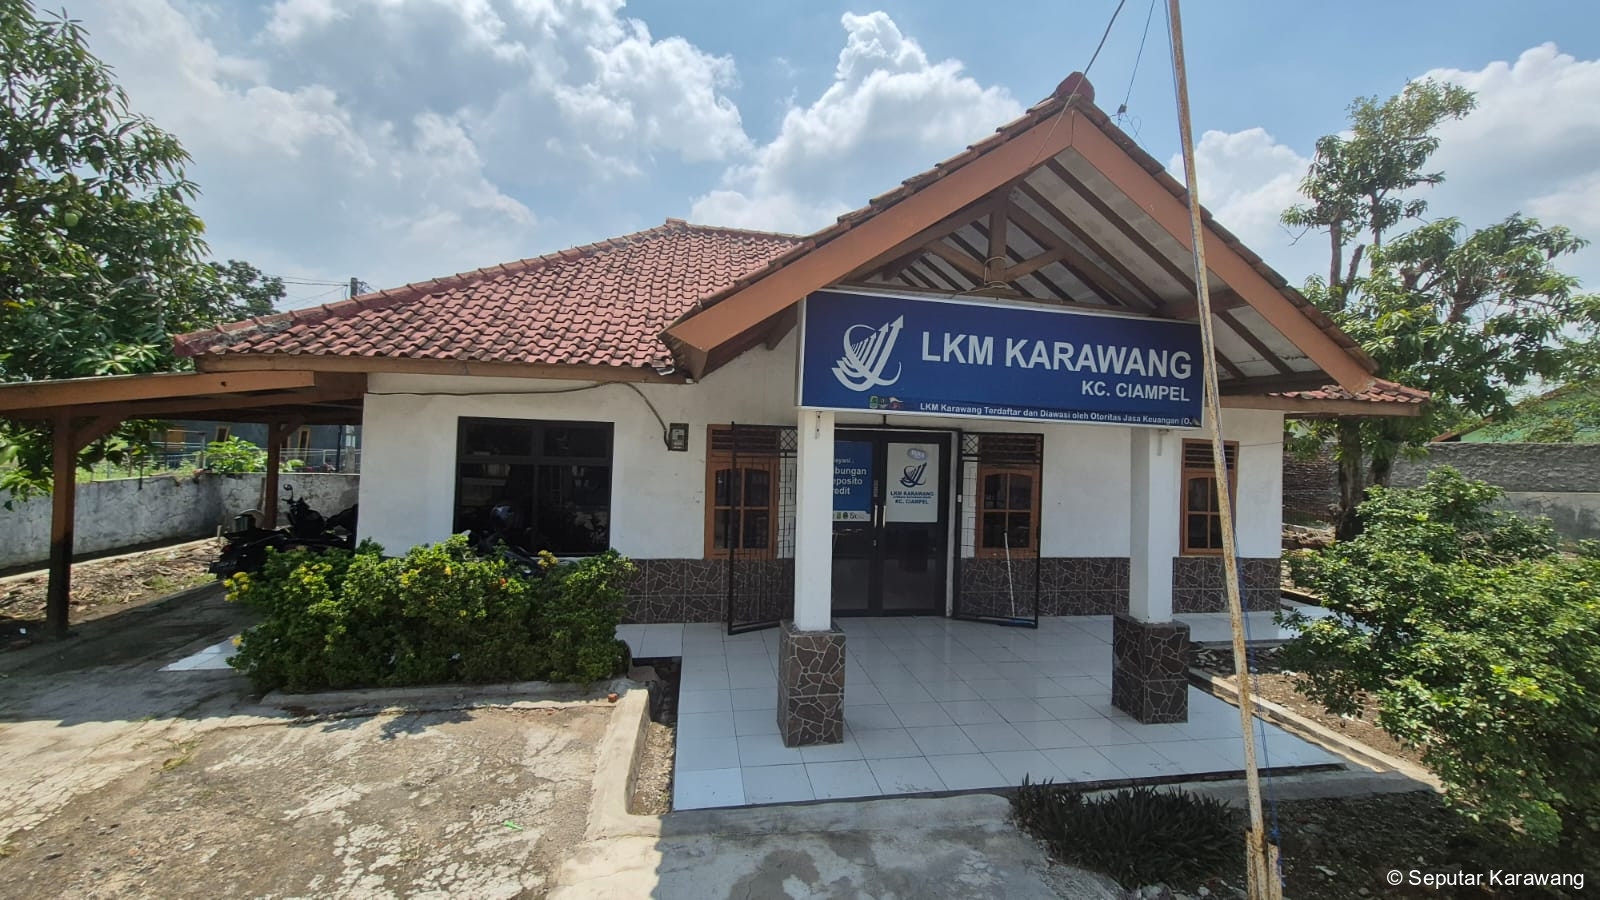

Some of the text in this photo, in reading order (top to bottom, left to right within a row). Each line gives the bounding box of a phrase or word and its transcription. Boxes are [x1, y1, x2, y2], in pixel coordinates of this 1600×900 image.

[921, 331, 1192, 380] LKM KARAWANG
[1081, 380, 1190, 402] KC. CIAMPEL
[920, 402, 939, 411] LKM
[940, 403, 982, 415] Karawang
[984, 406, 1022, 416] Terdaftar
[1023, 408, 1038, 417] dan
[1040, 409, 1071, 418] Diawasi
[1072, 411, 1089, 420] oleh
[1090, 412, 1121, 422] Otoritas
[1122, 414, 1141, 422] Jasa
[1142, 415, 1180, 425] Keuangan
[834, 466, 867, 477] bungan
